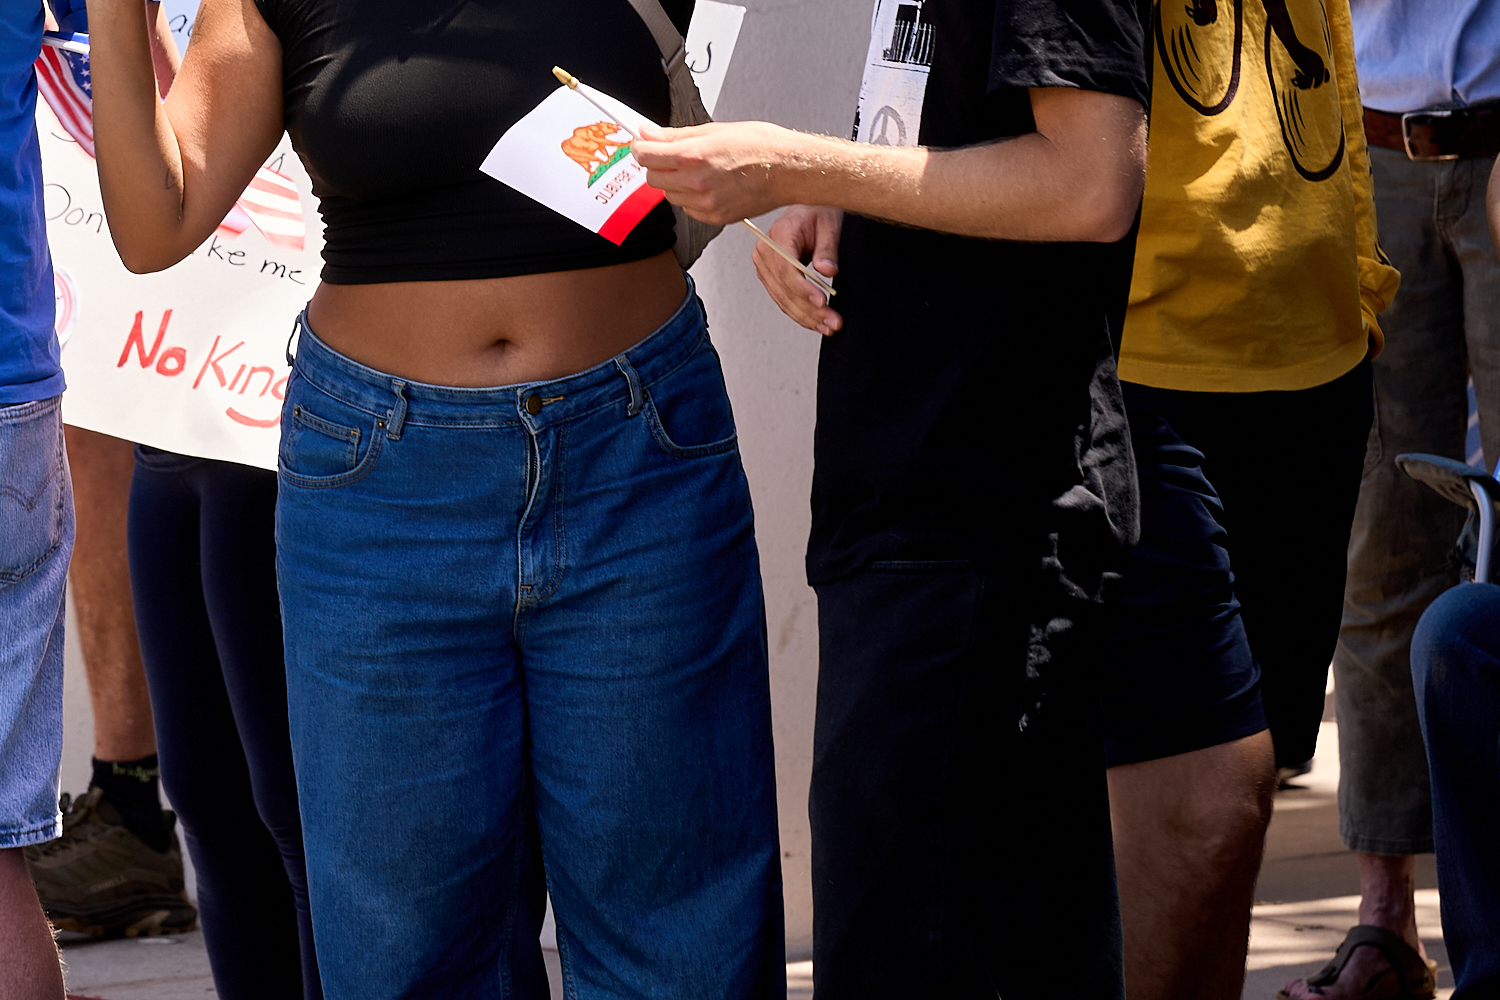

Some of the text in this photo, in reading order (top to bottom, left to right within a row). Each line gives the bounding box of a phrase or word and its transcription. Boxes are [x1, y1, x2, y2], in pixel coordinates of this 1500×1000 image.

[192, 235, 246, 266] ke
[260, 259, 306, 285] me
[117, 309, 187, 377] No
